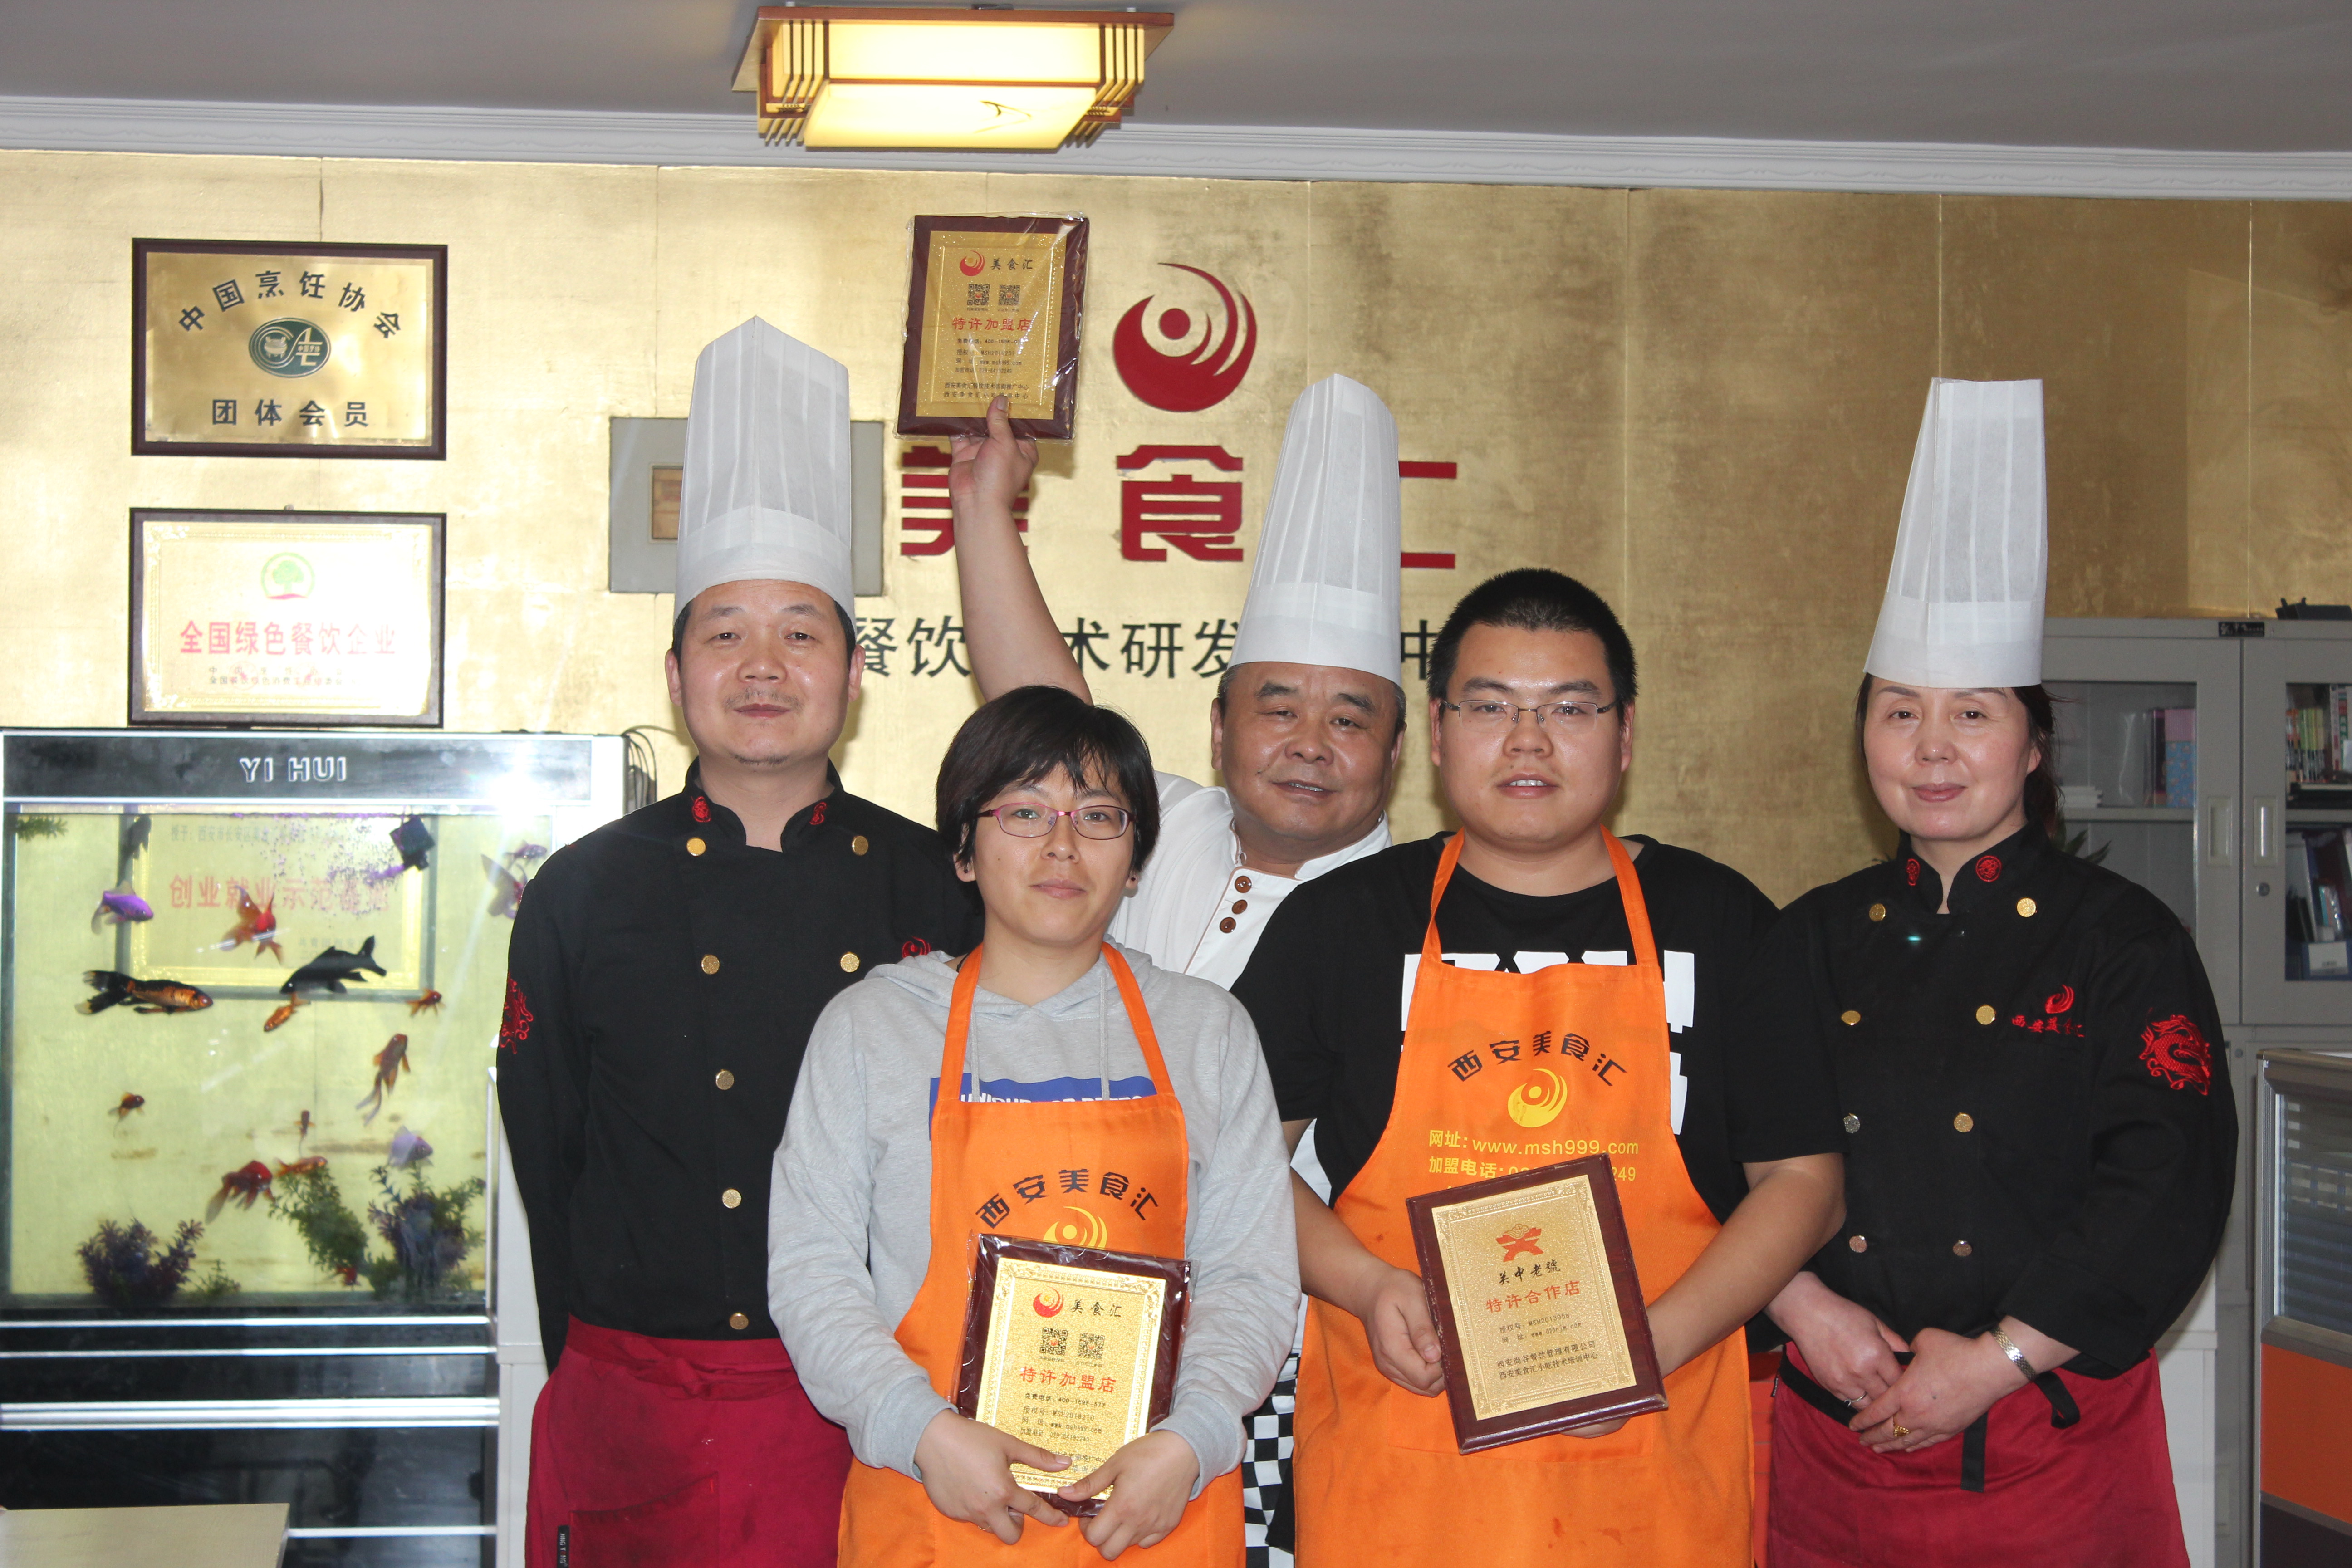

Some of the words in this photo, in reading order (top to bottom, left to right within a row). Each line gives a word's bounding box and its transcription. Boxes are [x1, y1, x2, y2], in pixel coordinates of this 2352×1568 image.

[991, 258, 1033, 270] 美食汇
[178, 270, 402, 338] 中国烹饪协会
[952, 318, 1033, 332] 特许加盟店
[212, 399, 369, 428] 团体会员
[180, 620, 396, 655] 全国绿色餐饮企业
[240, 758, 272, 782] YI
[289, 757, 347, 781] HUI
[1447, 1030, 1627, 1087] 西安美食汇
[975, 1168, 1158, 1229] 西安美食汇
[1070, 1298, 1123, 1318] 美食汇
[1486, 1280, 1581, 1313] 特许合作店
[1496, 1340, 1596, 1369] 西安尚谷餐饮管理有限公司
[1499, 1352, 1598, 1380] 西安美食汇小吃技术培训中心
[1019, 1366, 1117, 1393] 特许加盟店
